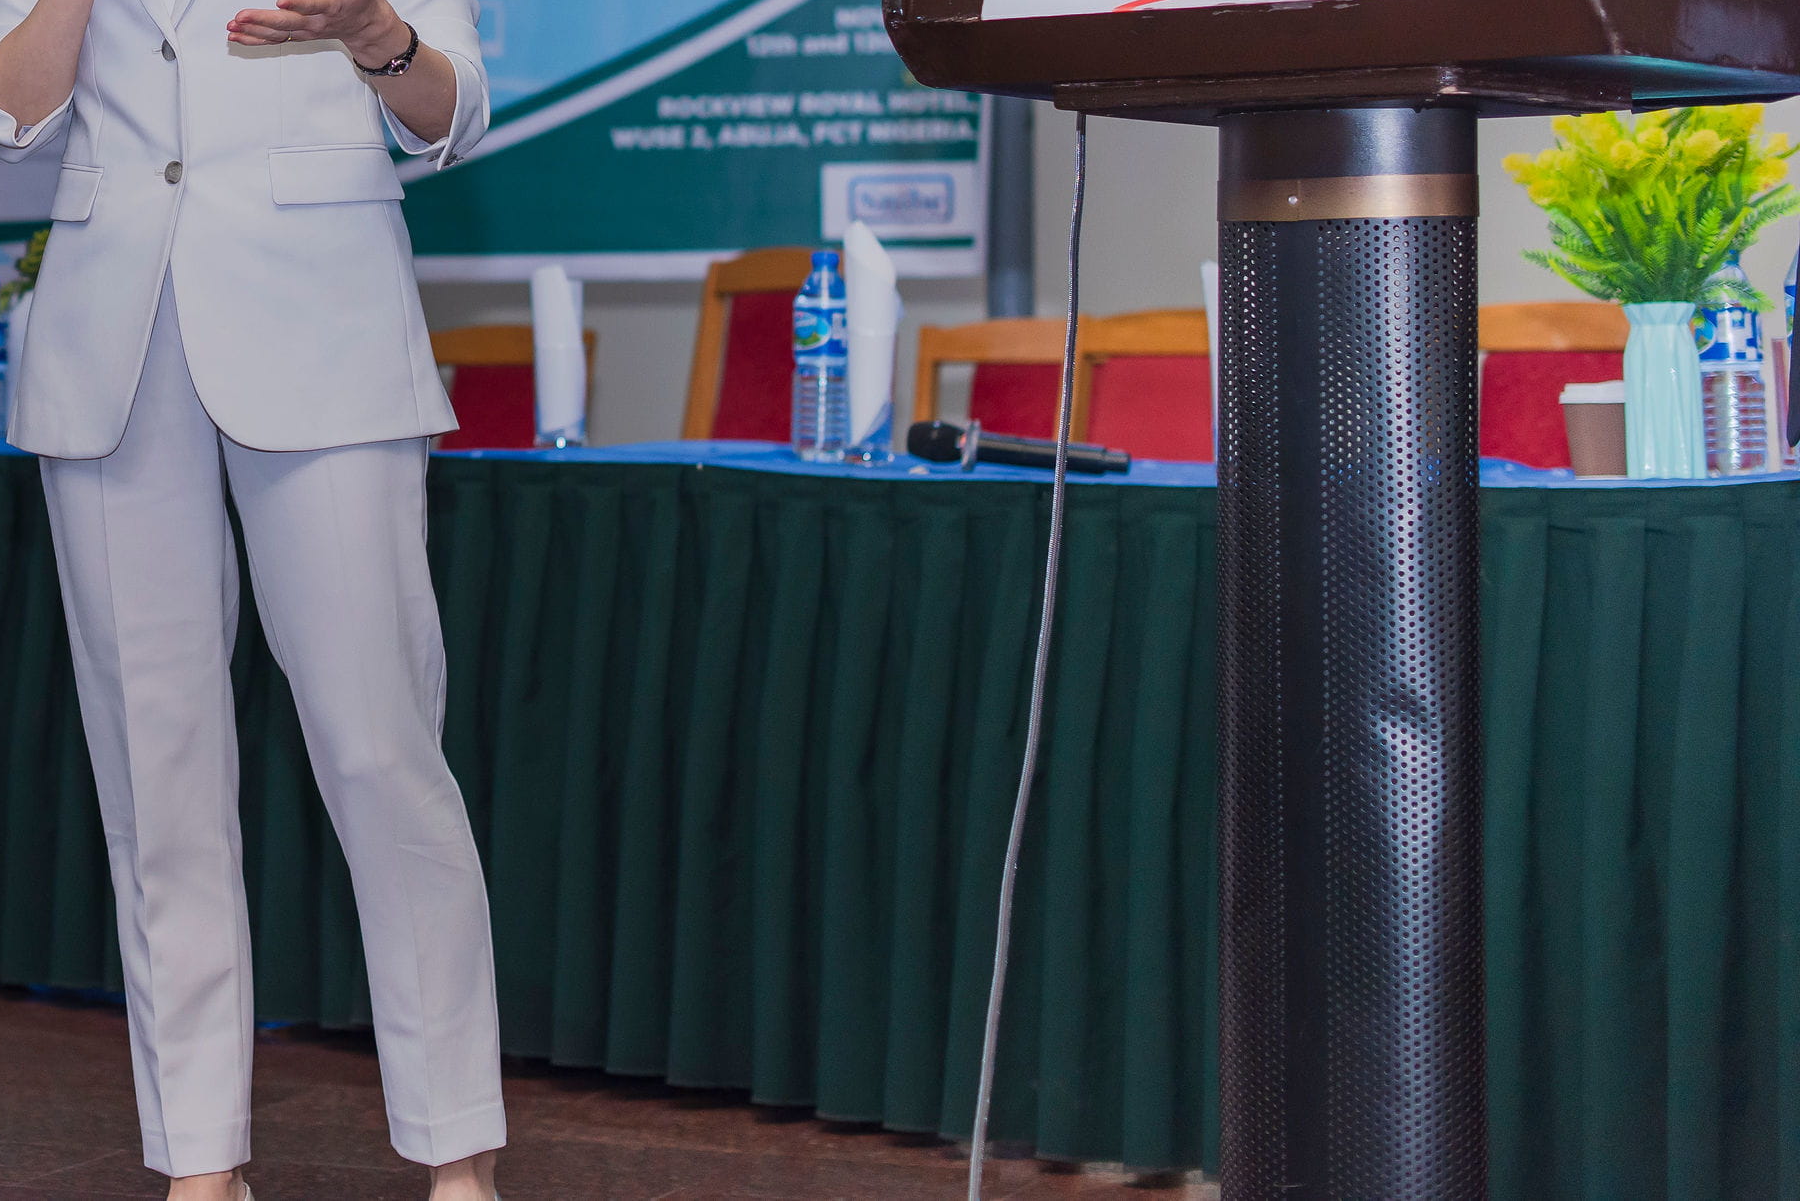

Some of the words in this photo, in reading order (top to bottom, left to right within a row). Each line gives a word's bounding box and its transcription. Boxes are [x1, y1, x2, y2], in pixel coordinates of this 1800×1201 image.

[657, 94, 795, 119] ROCKVIEW
[800, 92, 883, 116] ROYAL
[611, 126, 685, 150] WUSE
[813, 120, 862, 145] FCT
